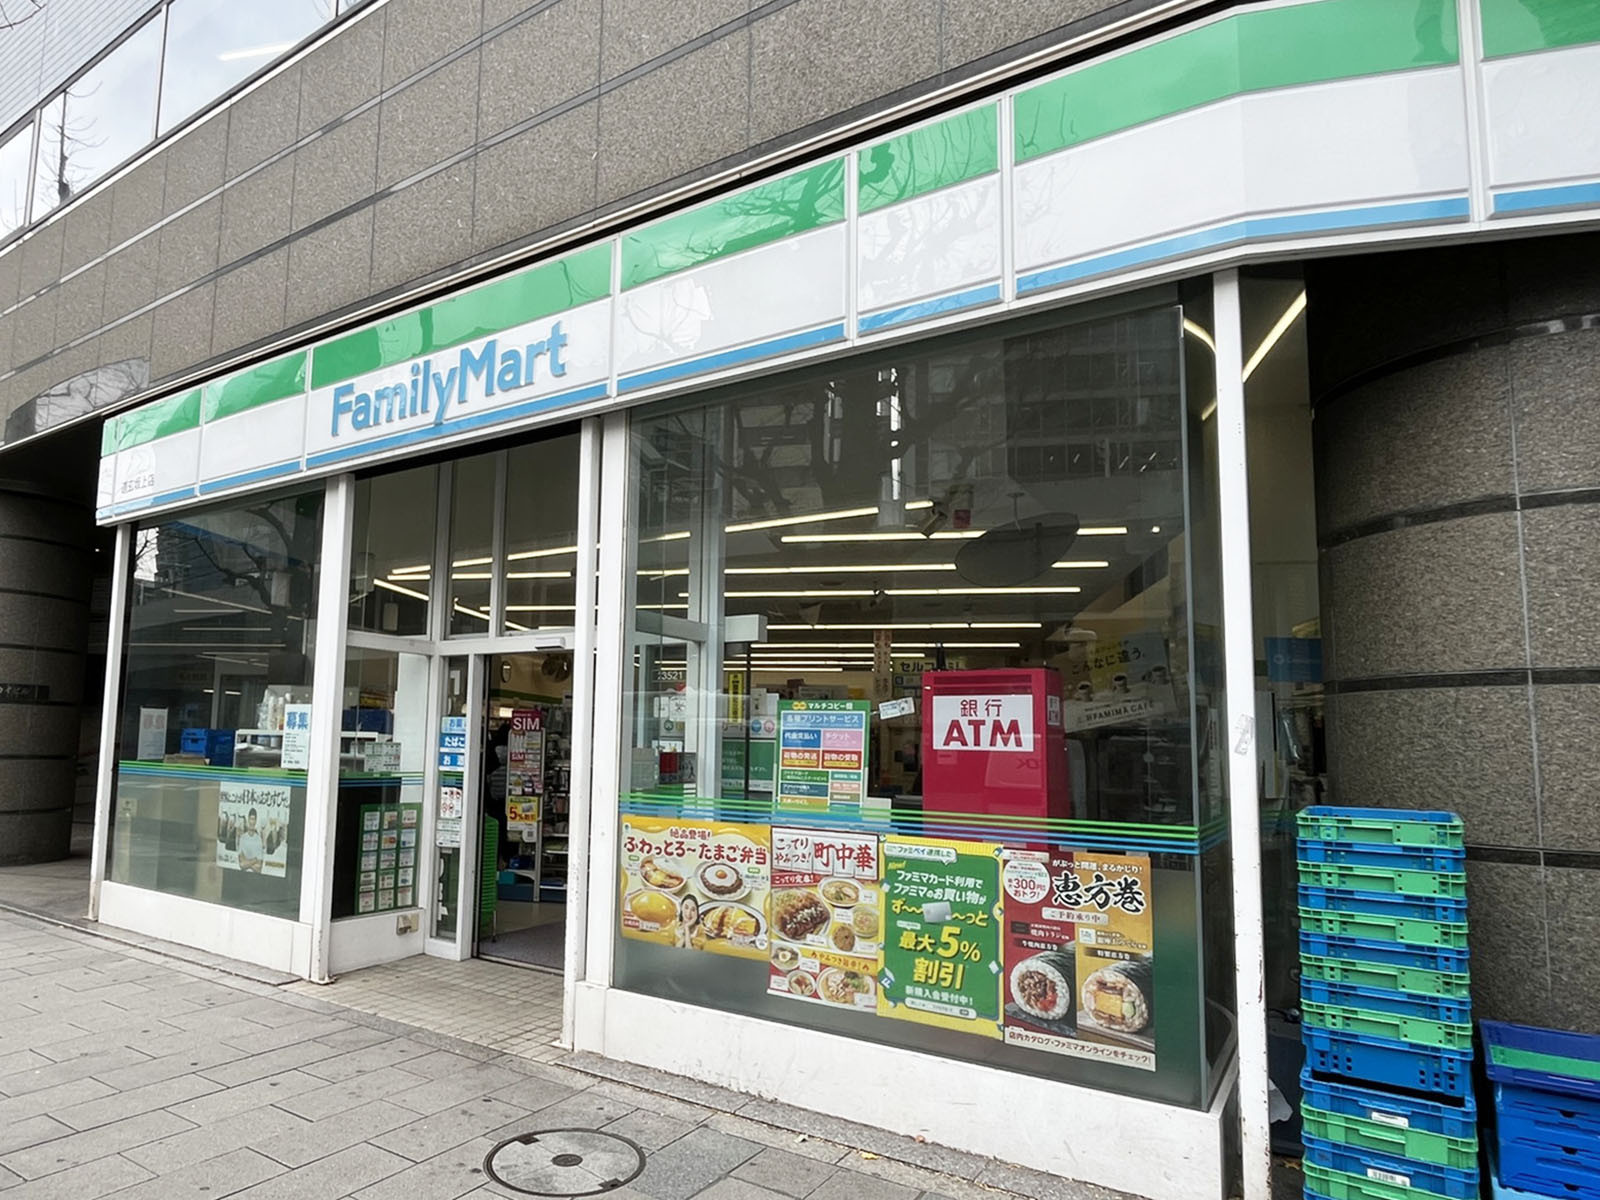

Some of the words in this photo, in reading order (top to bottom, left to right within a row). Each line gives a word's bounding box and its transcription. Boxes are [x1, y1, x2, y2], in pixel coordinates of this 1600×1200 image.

[331, 320, 568, 437] FamilyMart
[960, 699, 1003, 717] 銀行
[286, 711, 308, 731] 募集
[512, 717, 540, 731] SIM
[942, 719, 1023, 748] ATM
[776, 838, 808, 850] こってり
[774, 852, 811, 864] やみつき!
[813, 842, 875, 872] 町中華
[896, 870, 983, 889] ファミマカード利用で
[893, 882, 987, 905] ファミマのお買い物が
[1053, 871, 1145, 913] 恵方巻
[898, 925, 981, 962] 最大5%
[913, 956, 965, 990] 割引
